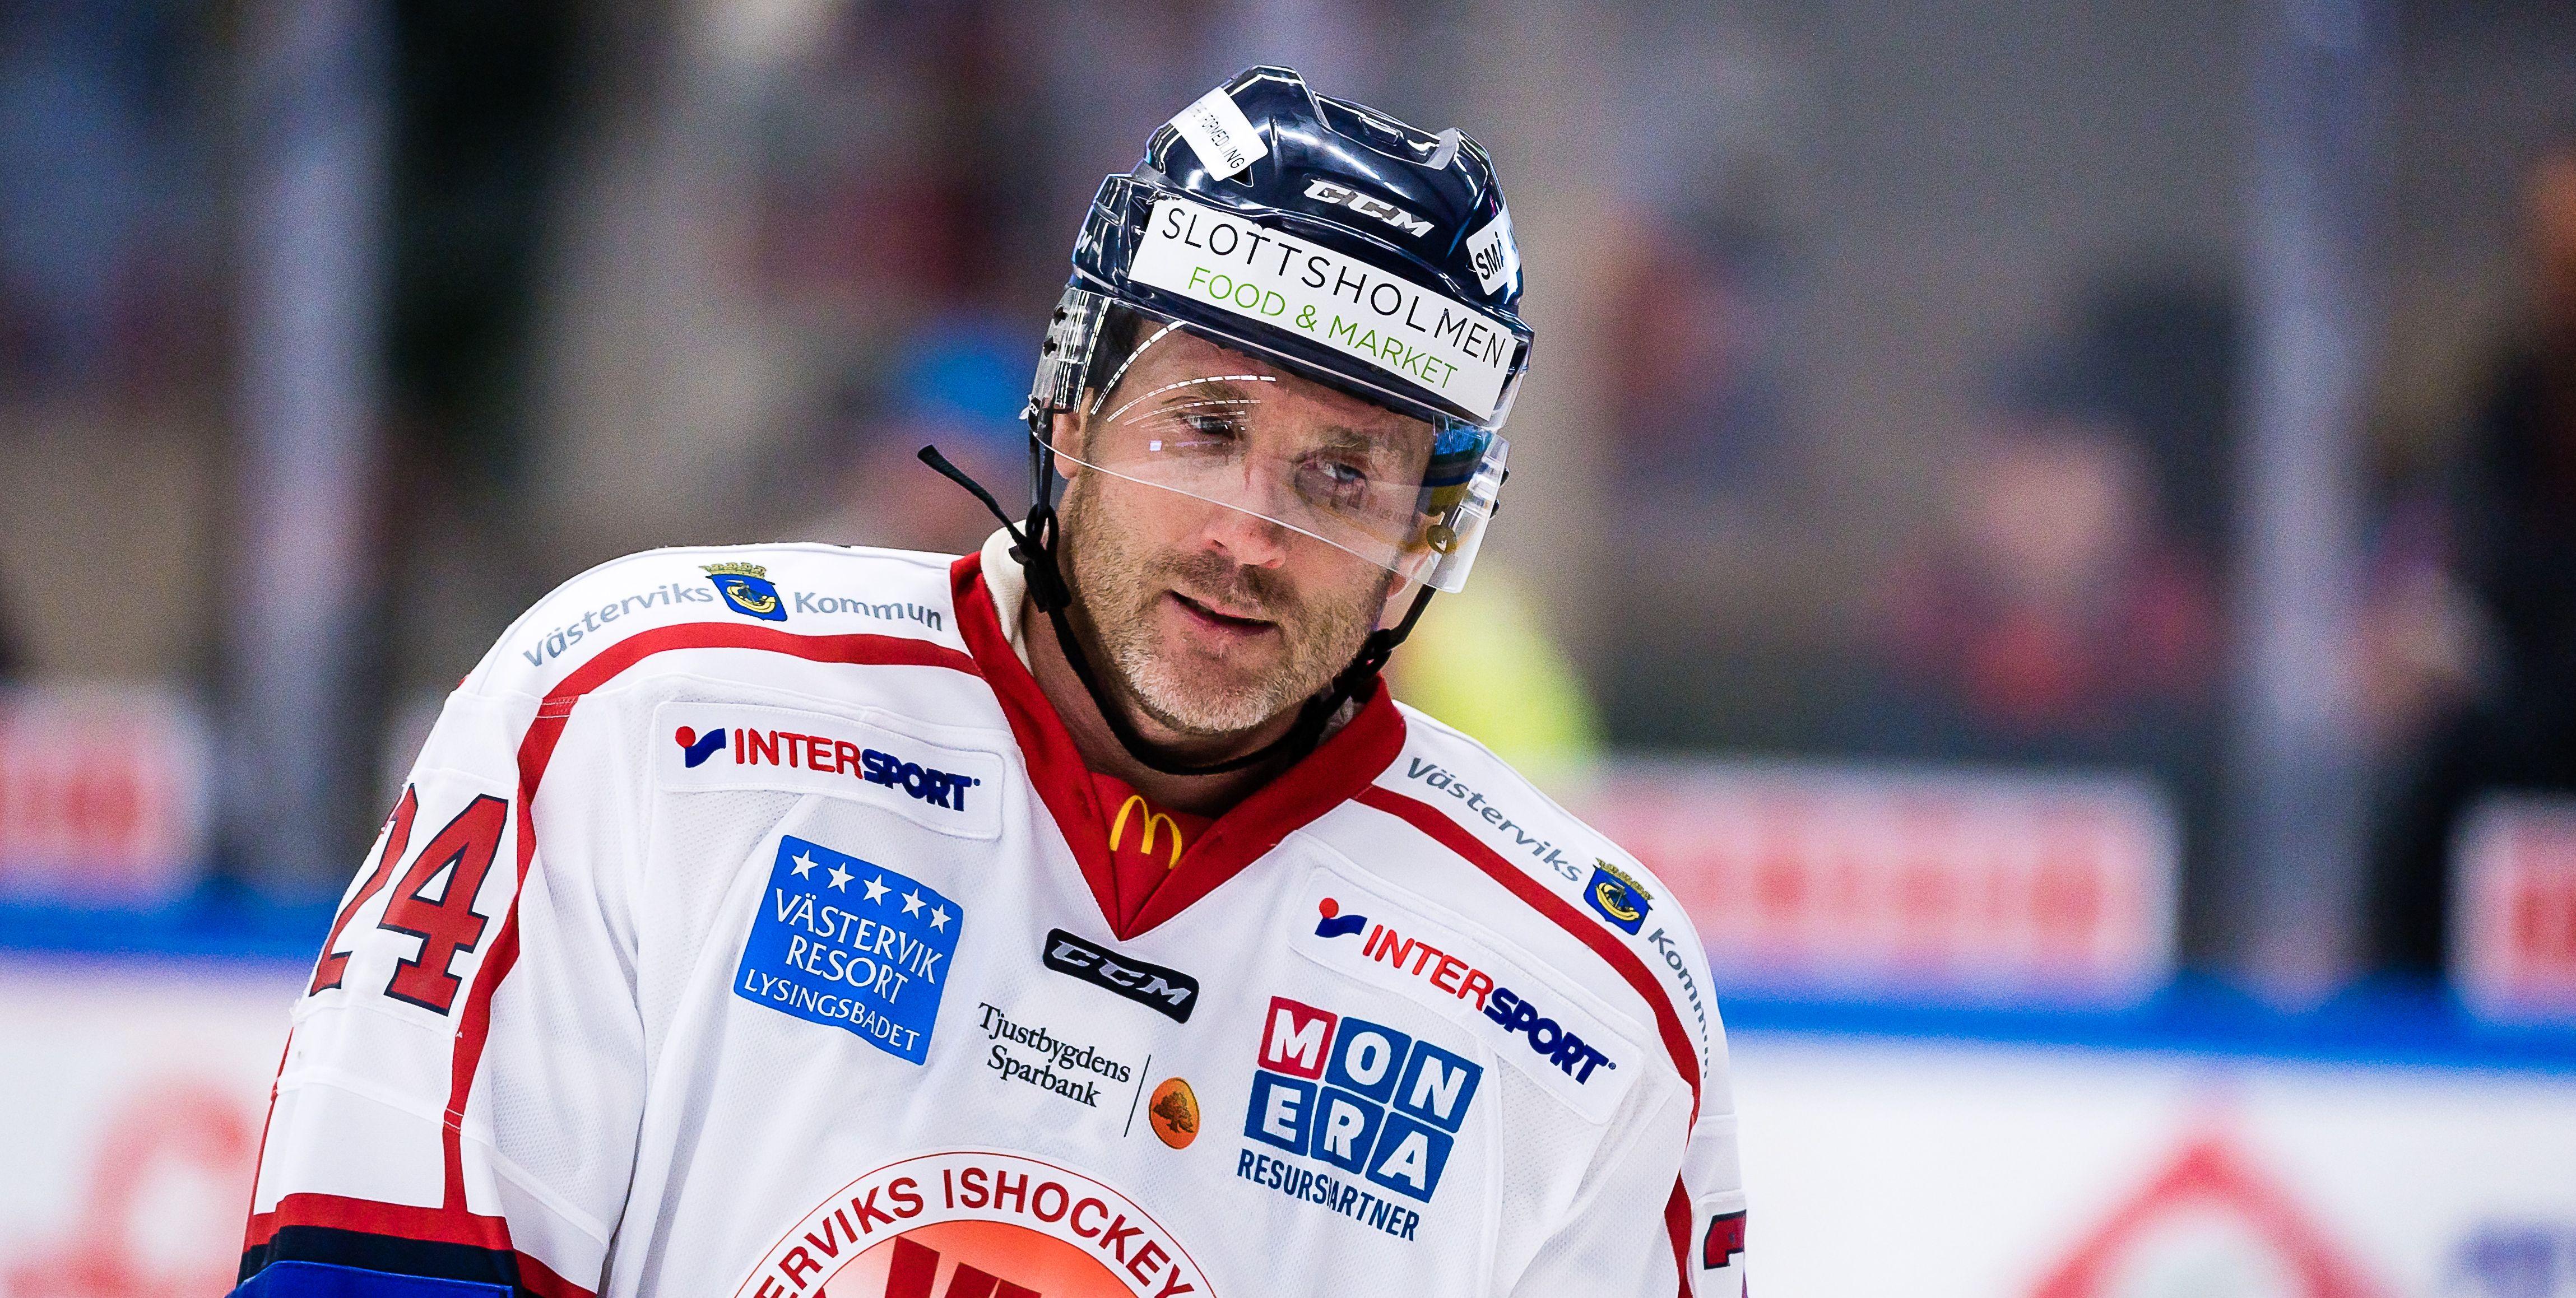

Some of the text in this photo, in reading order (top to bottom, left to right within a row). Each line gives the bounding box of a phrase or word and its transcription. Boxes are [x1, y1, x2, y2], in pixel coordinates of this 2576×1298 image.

[1303, 178, 1435, 238] CCM
[1161, 207, 1507, 368] SLOTTSHOLMEN
[1188, 266, 1458, 389] FOOD & MARKET
[795, 591, 943, 631] Kommun
[735, 727, 981, 811] INTERSPORT
[1407, 756, 1584, 884] Västerviks
[776, 887, 944, 984] VÄSTERVIK
[786, 934, 909, 1005] RESORT
[1051, 939, 1194, 1007] CCM
[744, 968, 921, 1053] LYSINGSBADET
[979, 1002, 1131, 1083] Tjustbygdens
[1363, 924, 1617, 1086] INTERSPORT
[986, 1044, 1101, 1108] Sparbank
[943, 1166, 1195, 1298] ISHOCKEY
